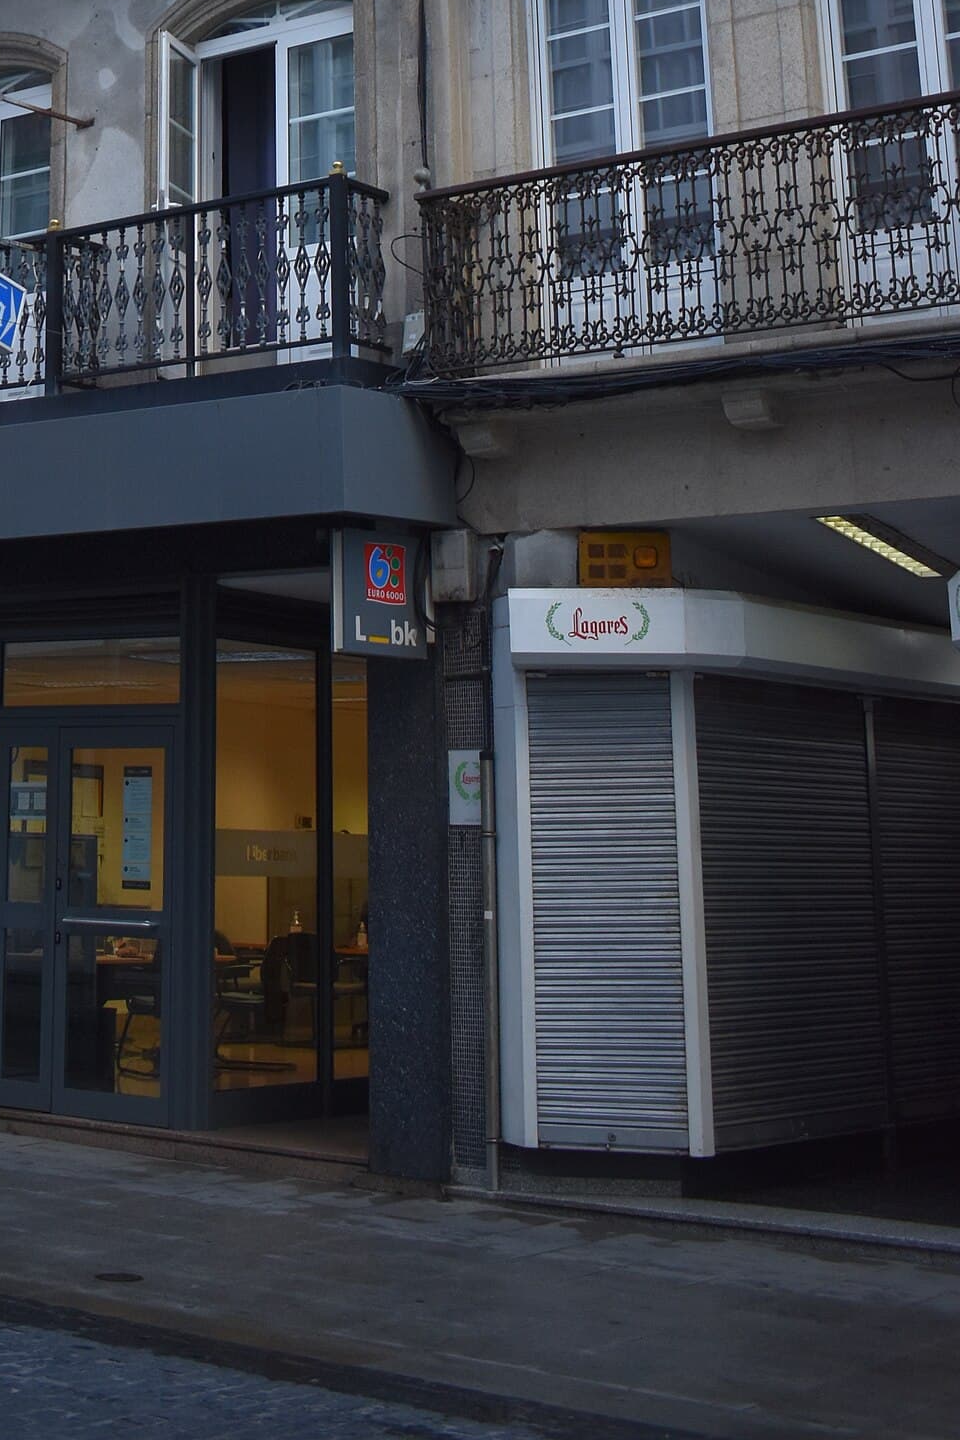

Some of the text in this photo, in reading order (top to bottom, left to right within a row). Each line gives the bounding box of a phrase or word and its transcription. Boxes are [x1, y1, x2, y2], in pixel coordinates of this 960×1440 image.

[367, 588, 404, 601] EURO 6000
[568, 607, 628, 640] Lagares
